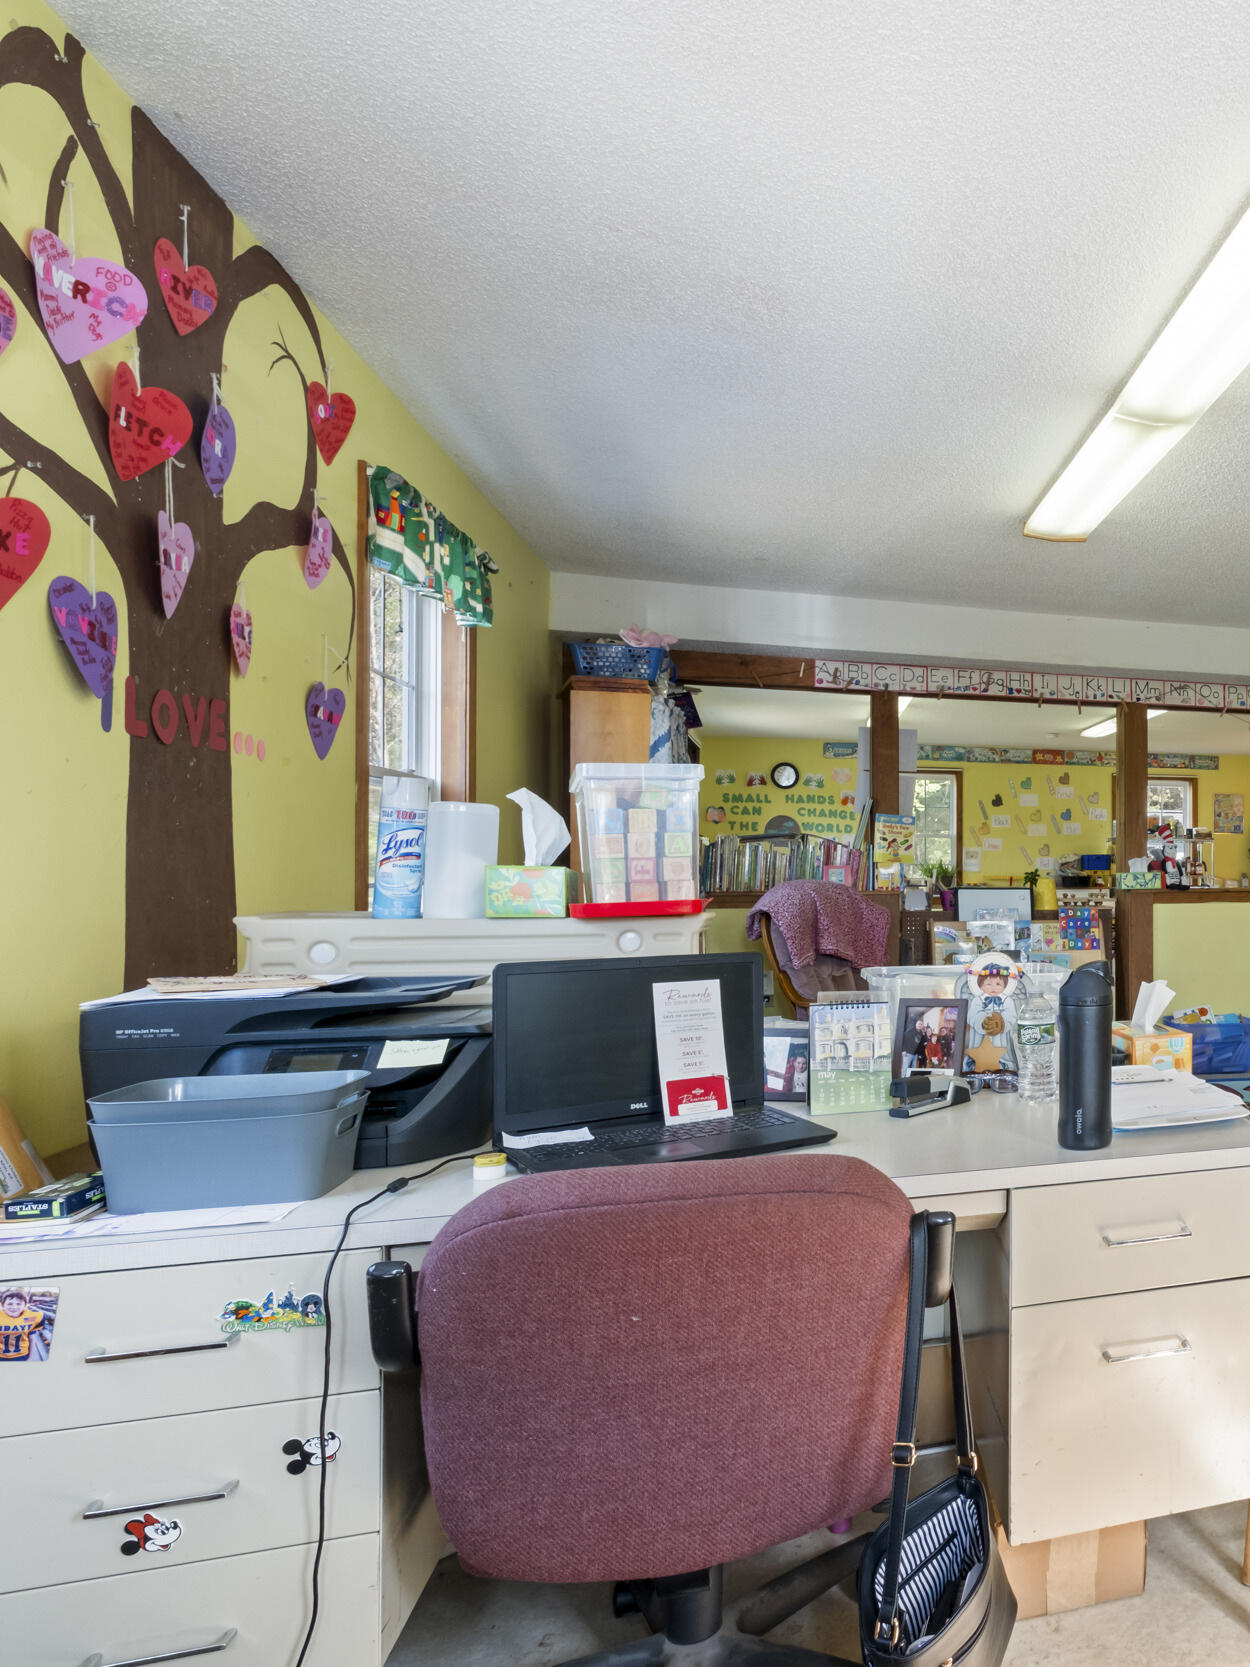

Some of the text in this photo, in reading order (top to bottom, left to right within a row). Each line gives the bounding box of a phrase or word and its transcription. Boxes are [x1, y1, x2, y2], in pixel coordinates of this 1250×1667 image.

[95, 266, 134, 287] FOOD
[848, 664, 869, 679] Bb
[874, 666, 897, 681] Cc
[902, 668, 925, 683] Dd
[930, 669, 949, 684] Ee
[957, 670, 976, 683] Ff
[1009, 673, 1030, 688] Hh
[1041, 674, 1049, 689] Ii
[1062, 677, 1076, 696] Jj
[1086, 678, 1103, 692] Kk
[1112, 680, 1126, 693] Ll
[1135, 681, 1161, 695] Mm
[1199, 684, 1220, 699] Oo
[1228, 686, 1244, 704] Pp
[722, 793, 835, 805] SMALL HANDS
[730, 805, 856, 821] CAN CHANGE
[728, 821, 853, 833] THE WORLD
[381, 832, 424, 856] Lysol
[818, 1071, 836, 1080] may
[630, 1102, 648, 1110] DELL
[1075, 1108, 1083, 1135] owala
[8, 1203, 48, 1212] STAPLES
[2, 1333, 23, 1354] 11
